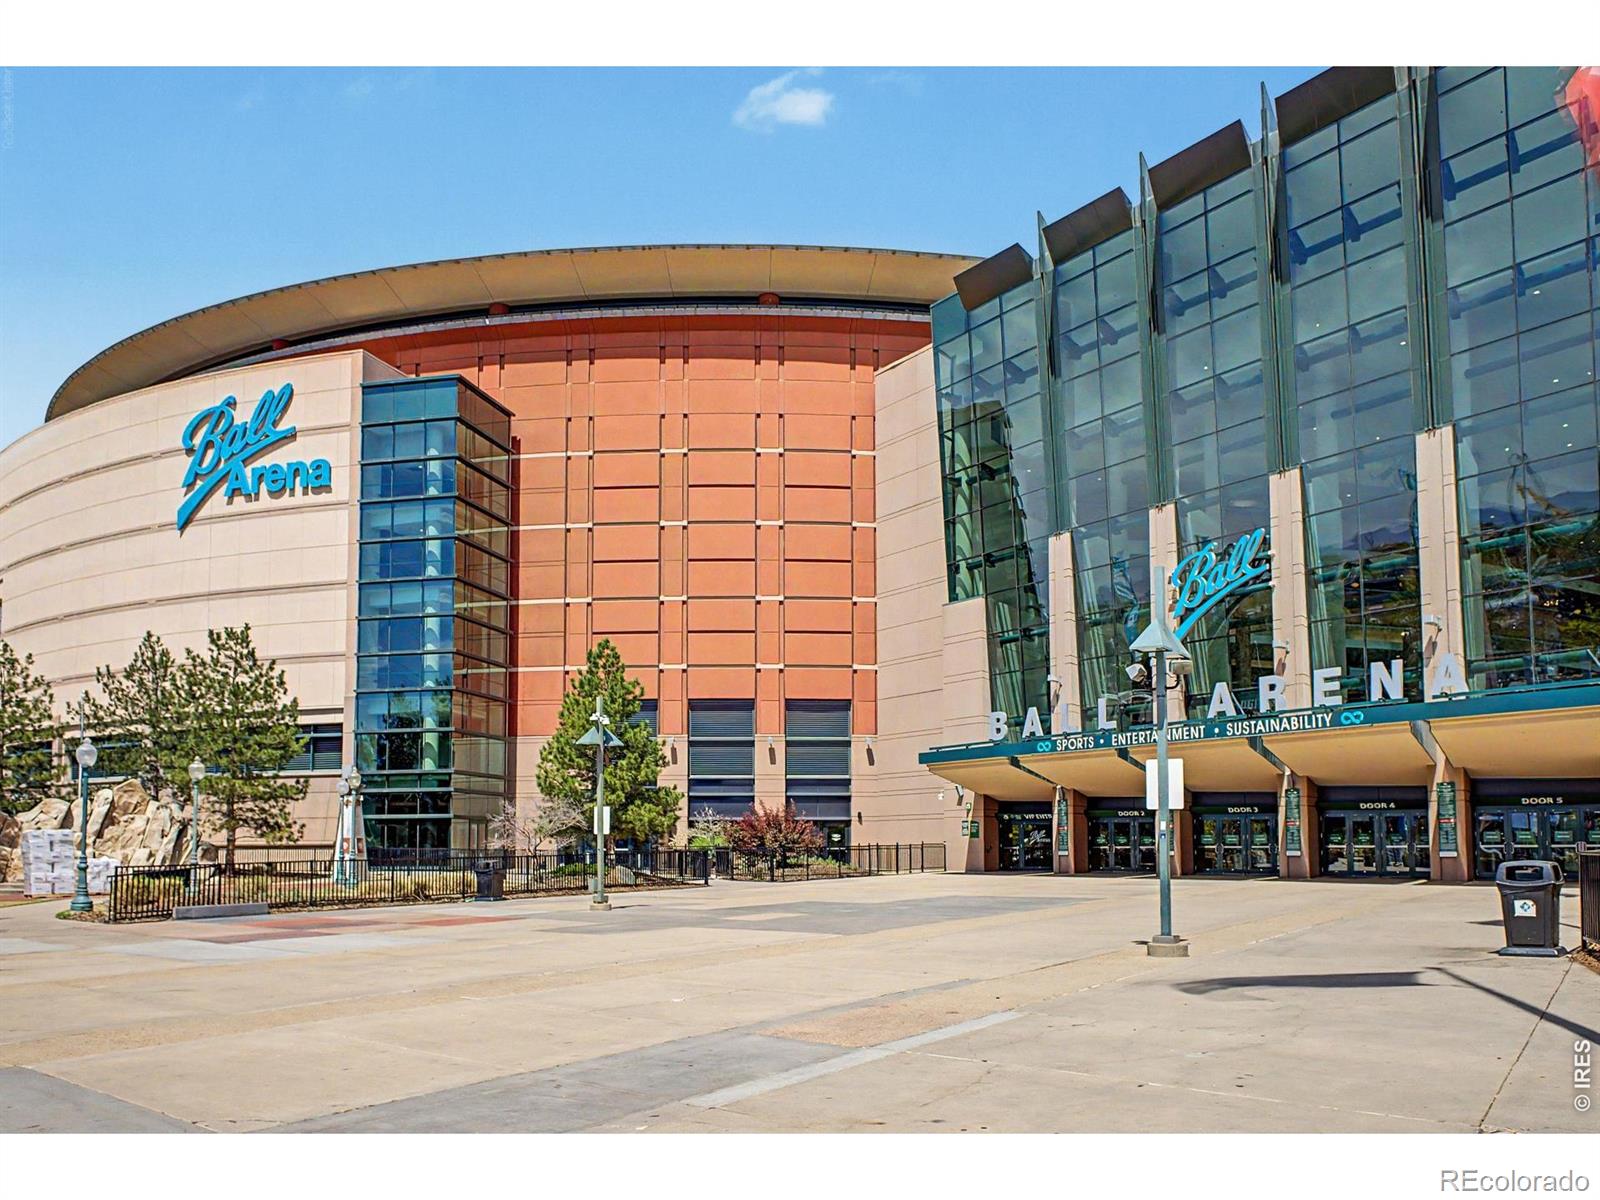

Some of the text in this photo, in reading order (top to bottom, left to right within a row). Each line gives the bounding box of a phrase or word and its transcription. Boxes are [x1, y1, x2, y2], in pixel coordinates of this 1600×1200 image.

[178, 382, 297, 531] Ball
[224, 458, 332, 497] Arena
[1171, 528, 1269, 641] Ball
[988, 653, 1470, 741] BALL ARENA
[1056, 713, 1333, 751] SPORTS ENTERTANMENT SUSTAINABILITY
